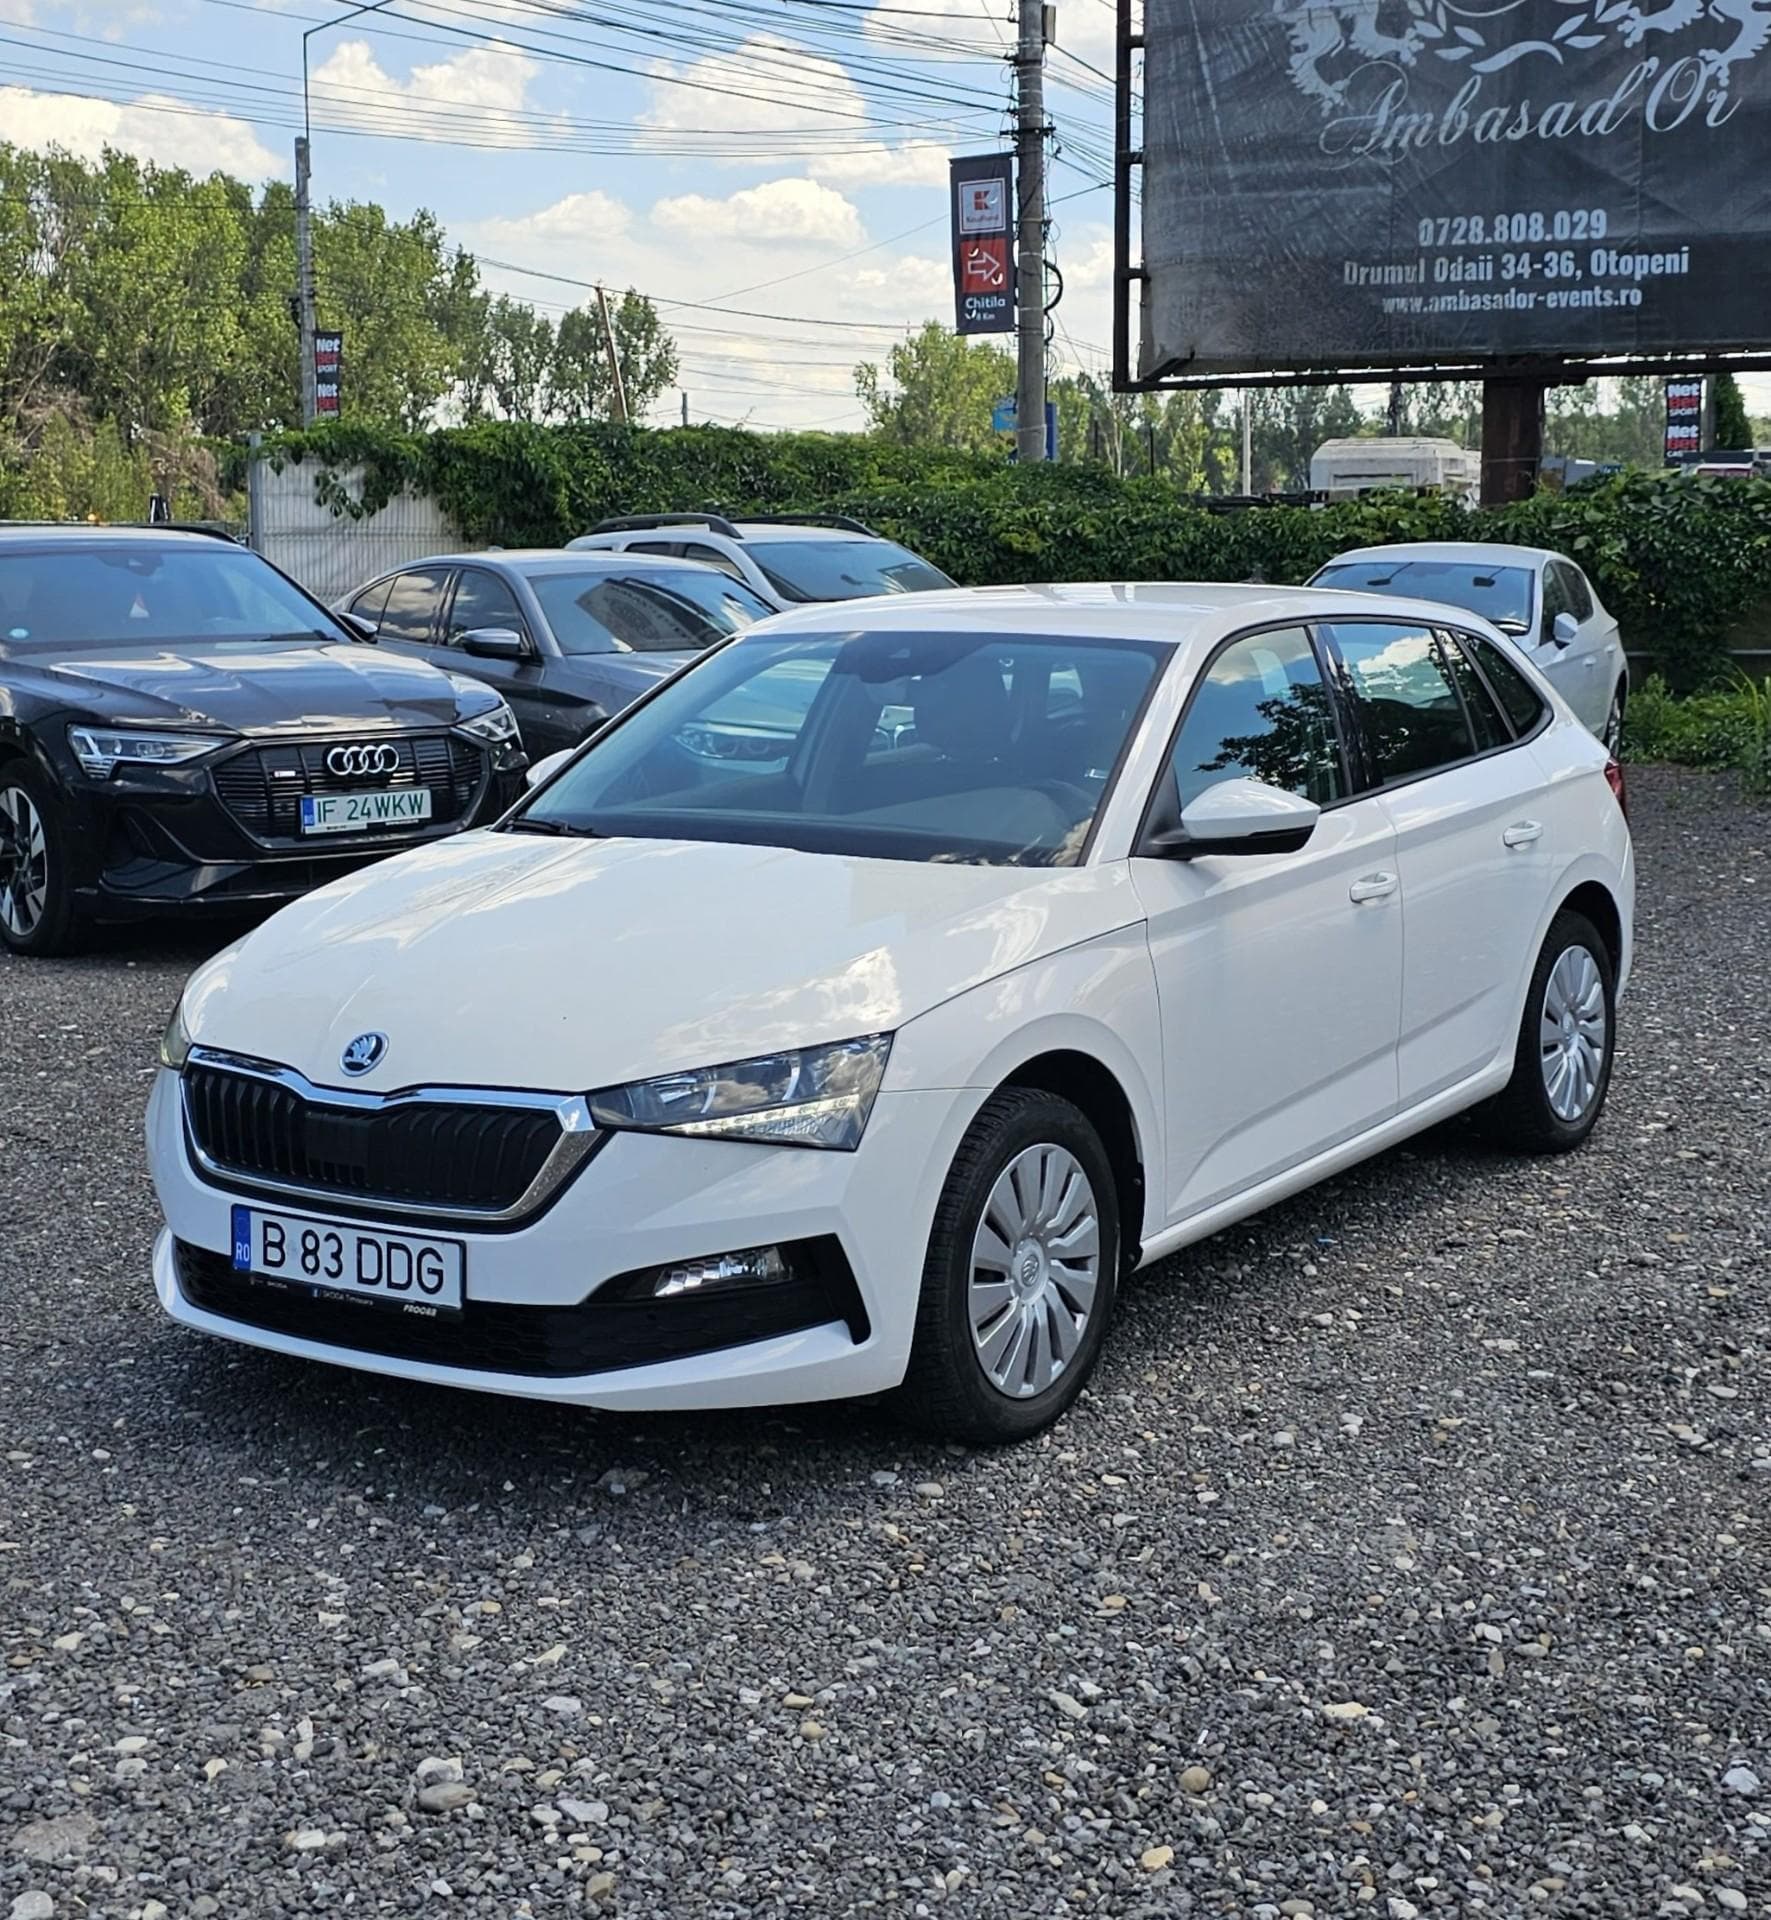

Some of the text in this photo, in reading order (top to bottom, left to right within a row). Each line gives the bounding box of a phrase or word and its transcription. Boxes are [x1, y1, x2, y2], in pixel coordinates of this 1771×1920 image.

[1318, 56, 1743, 170] Ambasad'Or
[1418, 209, 1607, 247] 0728.808.029
[1343, 246, 1690, 285] Drumul Odaii 34-36, Otopeni
[965, 296, 1006, 309] Chitila
[1382, 285, 1643, 313] www.ambasador-events.ro
[316, 338, 341, 352] Net
[317, 383, 338, 397] Net
[1667, 383, 1700, 397] Net
[1669, 397, 1698, 409] Bet
[1669, 408, 1698, 416] SPORT
[1667, 425, 1699, 439] Net
[1667, 439, 1698, 450] Bet
[317, 800, 337, 823] IF
[235, 1242, 250, 1262] RO
[262, 1220, 444, 1295] B 83 DDG
